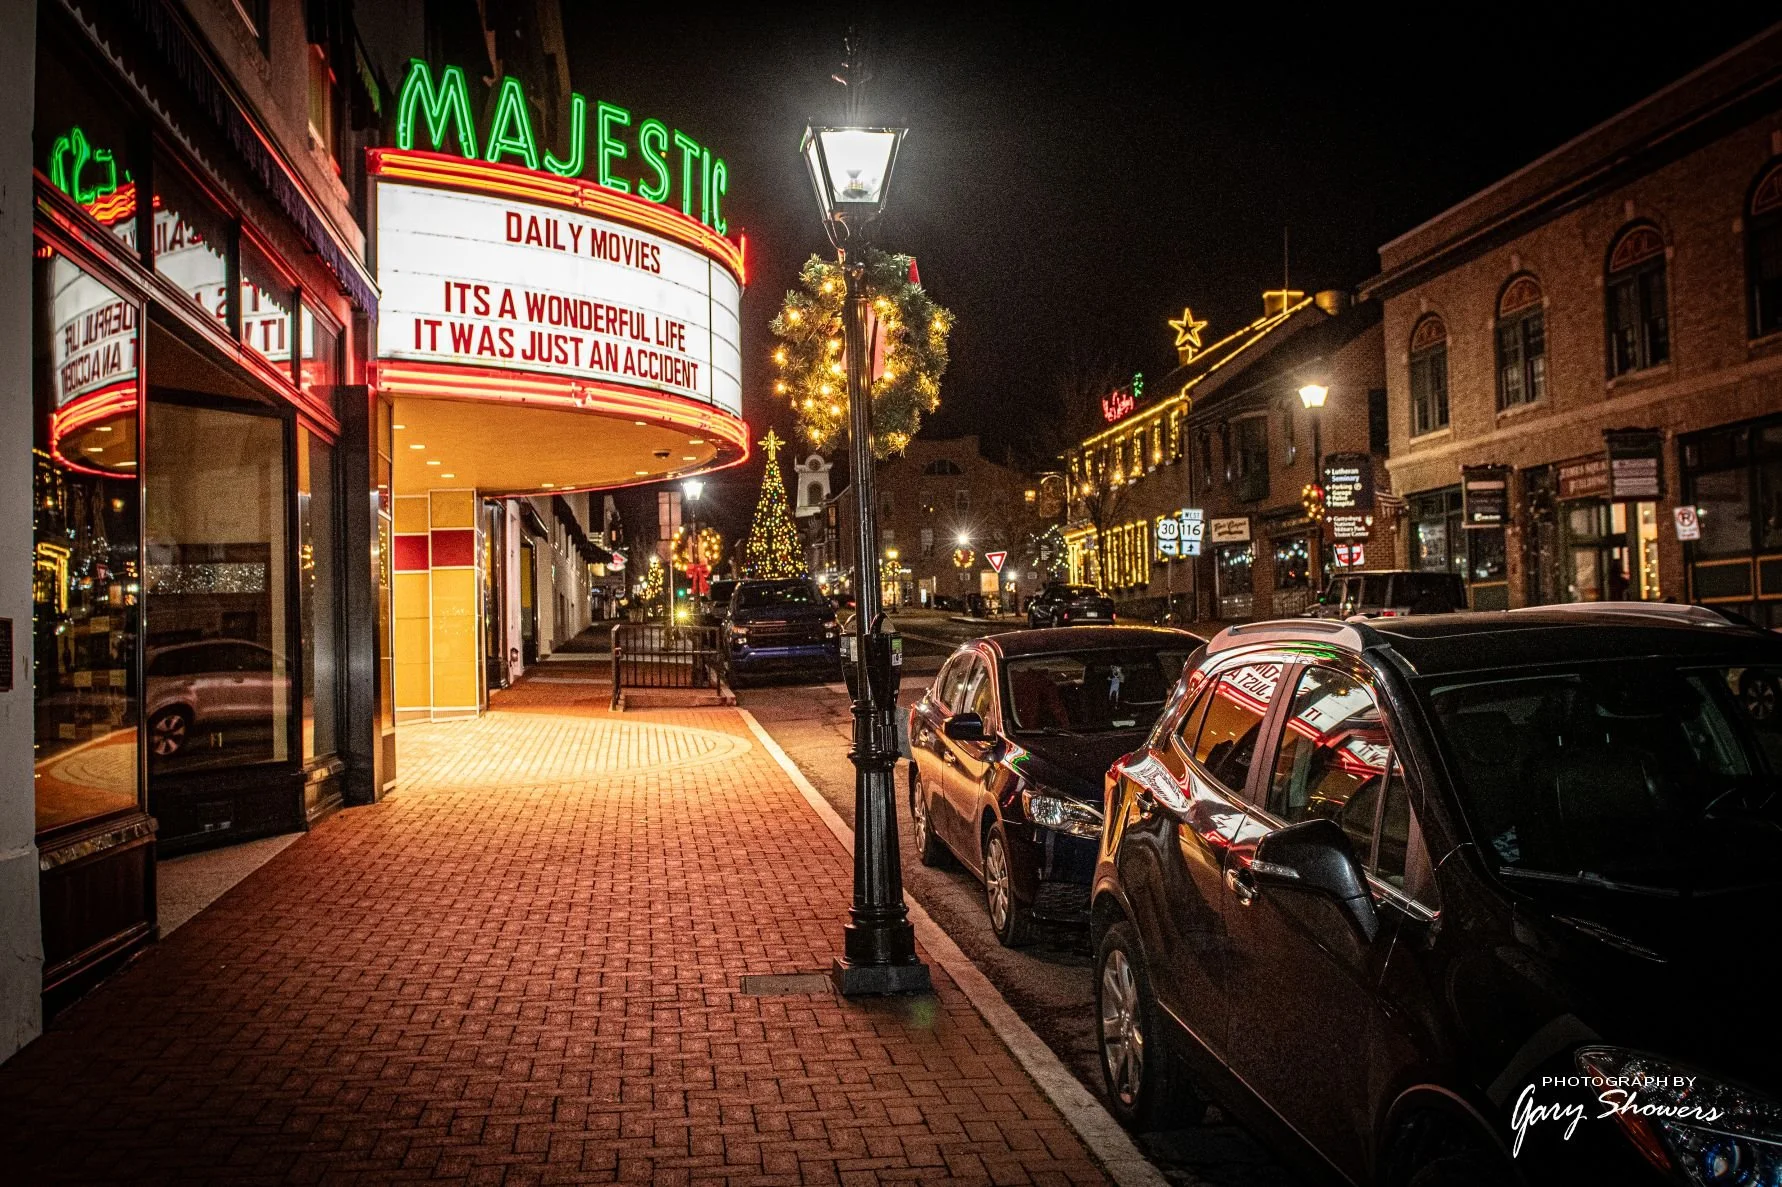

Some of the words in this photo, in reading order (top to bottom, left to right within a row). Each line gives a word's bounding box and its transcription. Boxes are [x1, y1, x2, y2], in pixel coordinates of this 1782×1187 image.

[396, 57, 728, 236] MAJESTIC
[506, 211, 584, 253] DAILY
[591, 228, 661, 274] MOVIES
[445, 281, 490, 316] ITS
[499, 289, 517, 320] A
[525, 291, 651, 344] WONDERFUL
[655, 320, 686, 353] LIFE
[415, 318, 442, 351] IT
[450, 321, 514, 358] WAS
[521, 330, 584, 367] JUST
[590, 340, 619, 374] AN
[623, 346, 698, 391] ACCIDENT
[1331, 475, 1360, 483] Seminary
[1161, 523, 1175, 535] 30
[1182, 524, 1201, 536] 116
